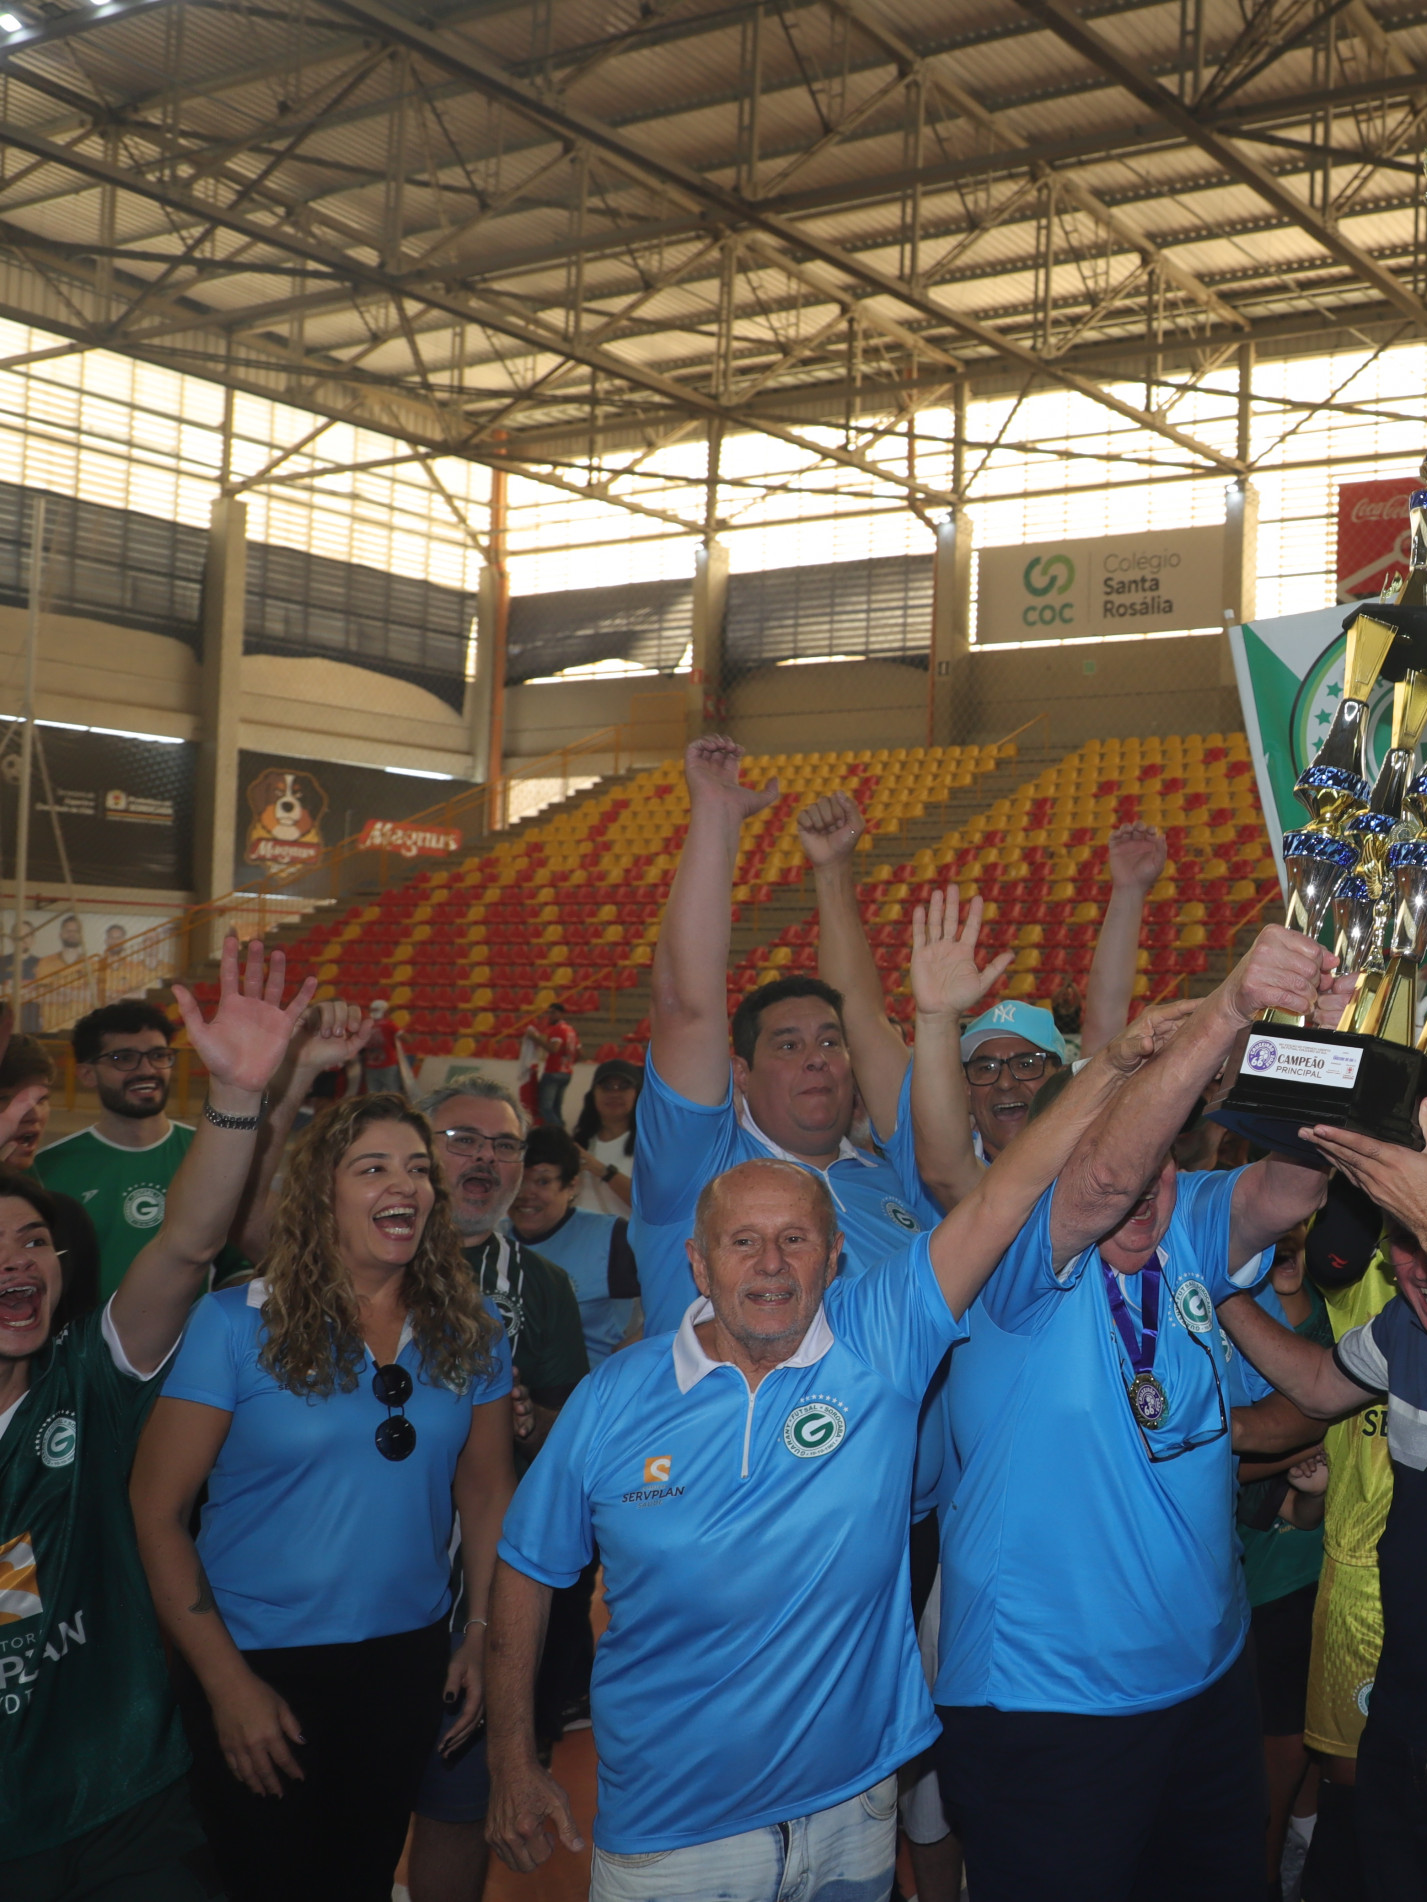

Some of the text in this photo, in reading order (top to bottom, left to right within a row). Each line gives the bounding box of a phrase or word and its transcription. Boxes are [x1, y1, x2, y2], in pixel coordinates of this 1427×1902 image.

[1103, 550, 1182, 574] Colégio
[1103, 575, 1160, 596] Santa
[1022, 603, 1075, 626] COC
[1103, 596, 1174, 618] Rosália
[359, 822, 457, 857] Magnus
[1251, 1056, 1264, 1067] 66
[1275, 1065, 1322, 1079] PRINCIPAL
[1277, 1053, 1325, 1070] CAMPEÃO
[621, 1486, 685, 1503] SERVPLAN
